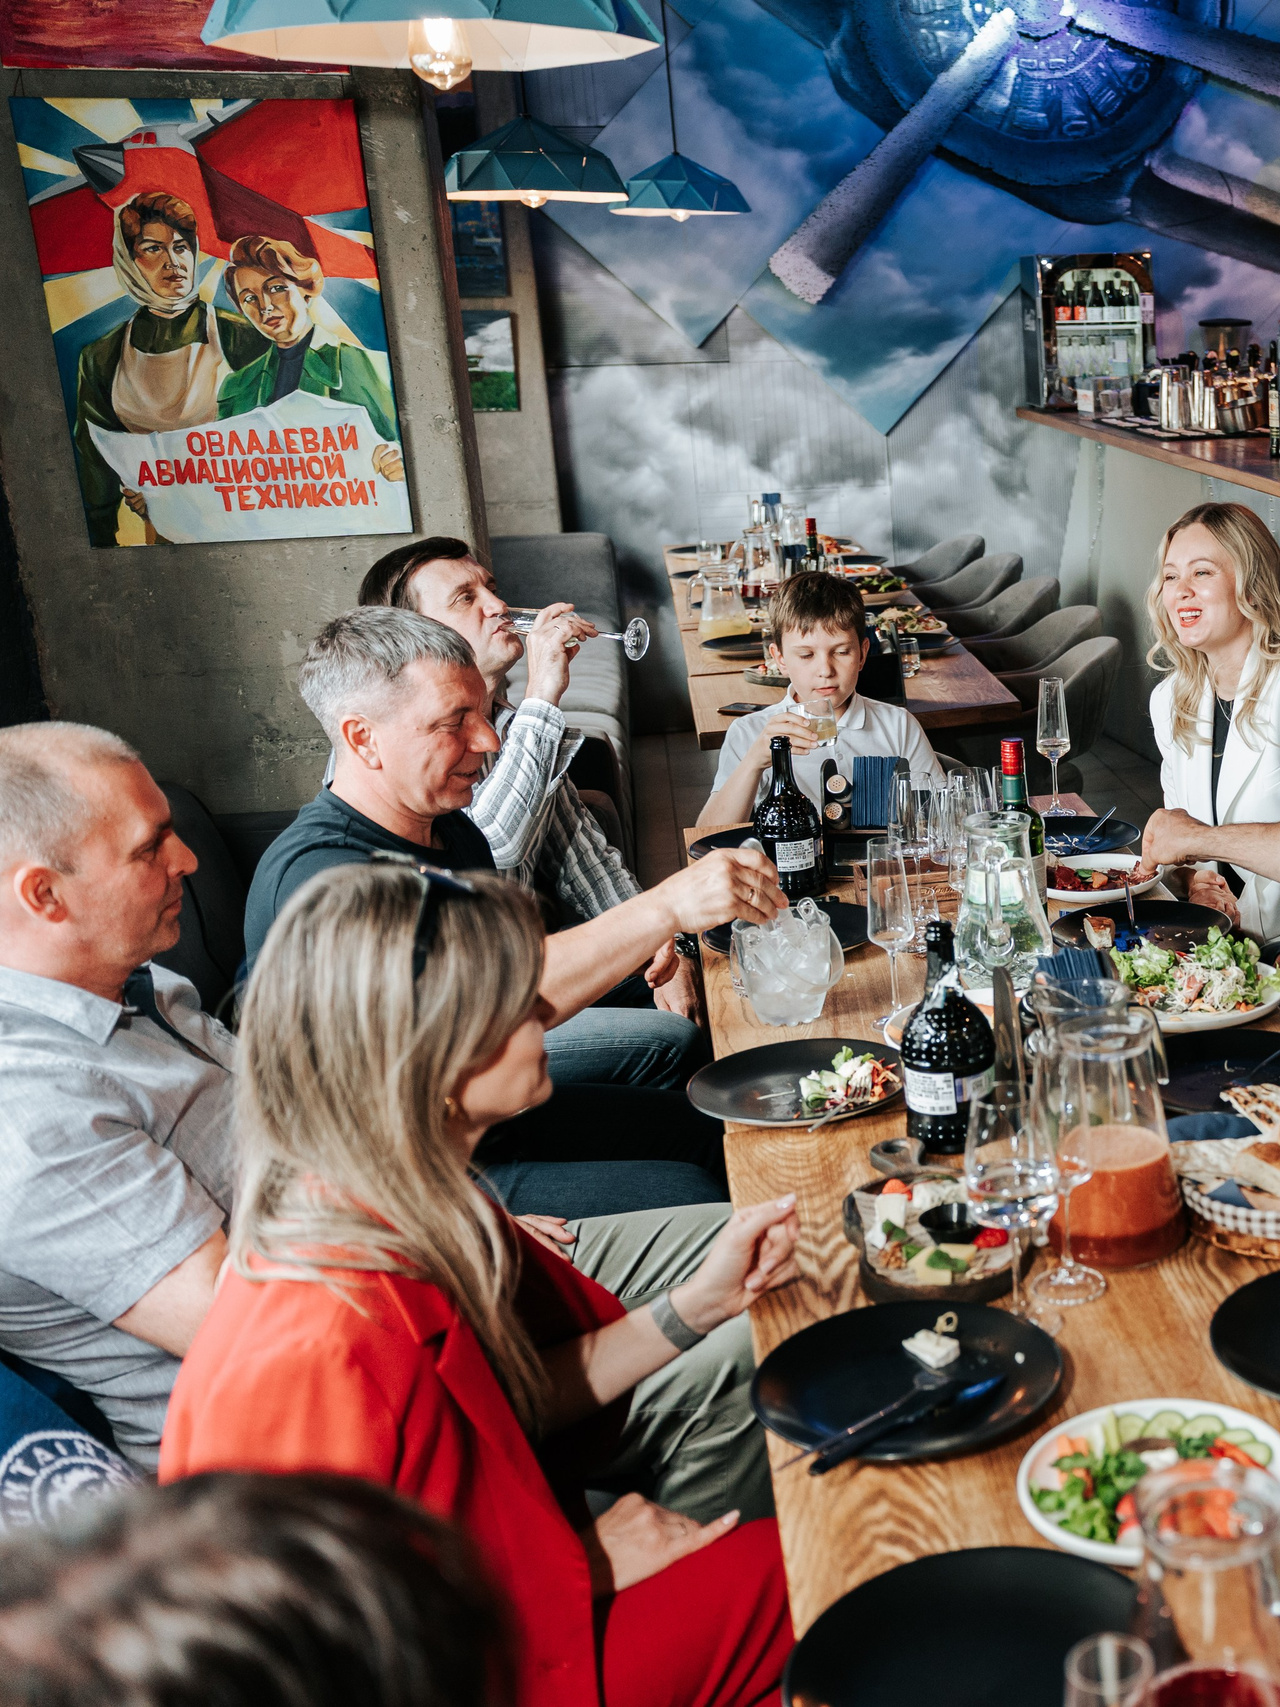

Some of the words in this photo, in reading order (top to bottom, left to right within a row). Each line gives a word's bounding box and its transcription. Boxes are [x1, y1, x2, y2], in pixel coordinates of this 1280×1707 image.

[186, 423, 359, 457] ОВЛАДЕВАЙ
[138, 452, 347, 487] АВИАЦИОННОЙ
[214, 478, 379, 512] ТЕХНИКОЙ!
